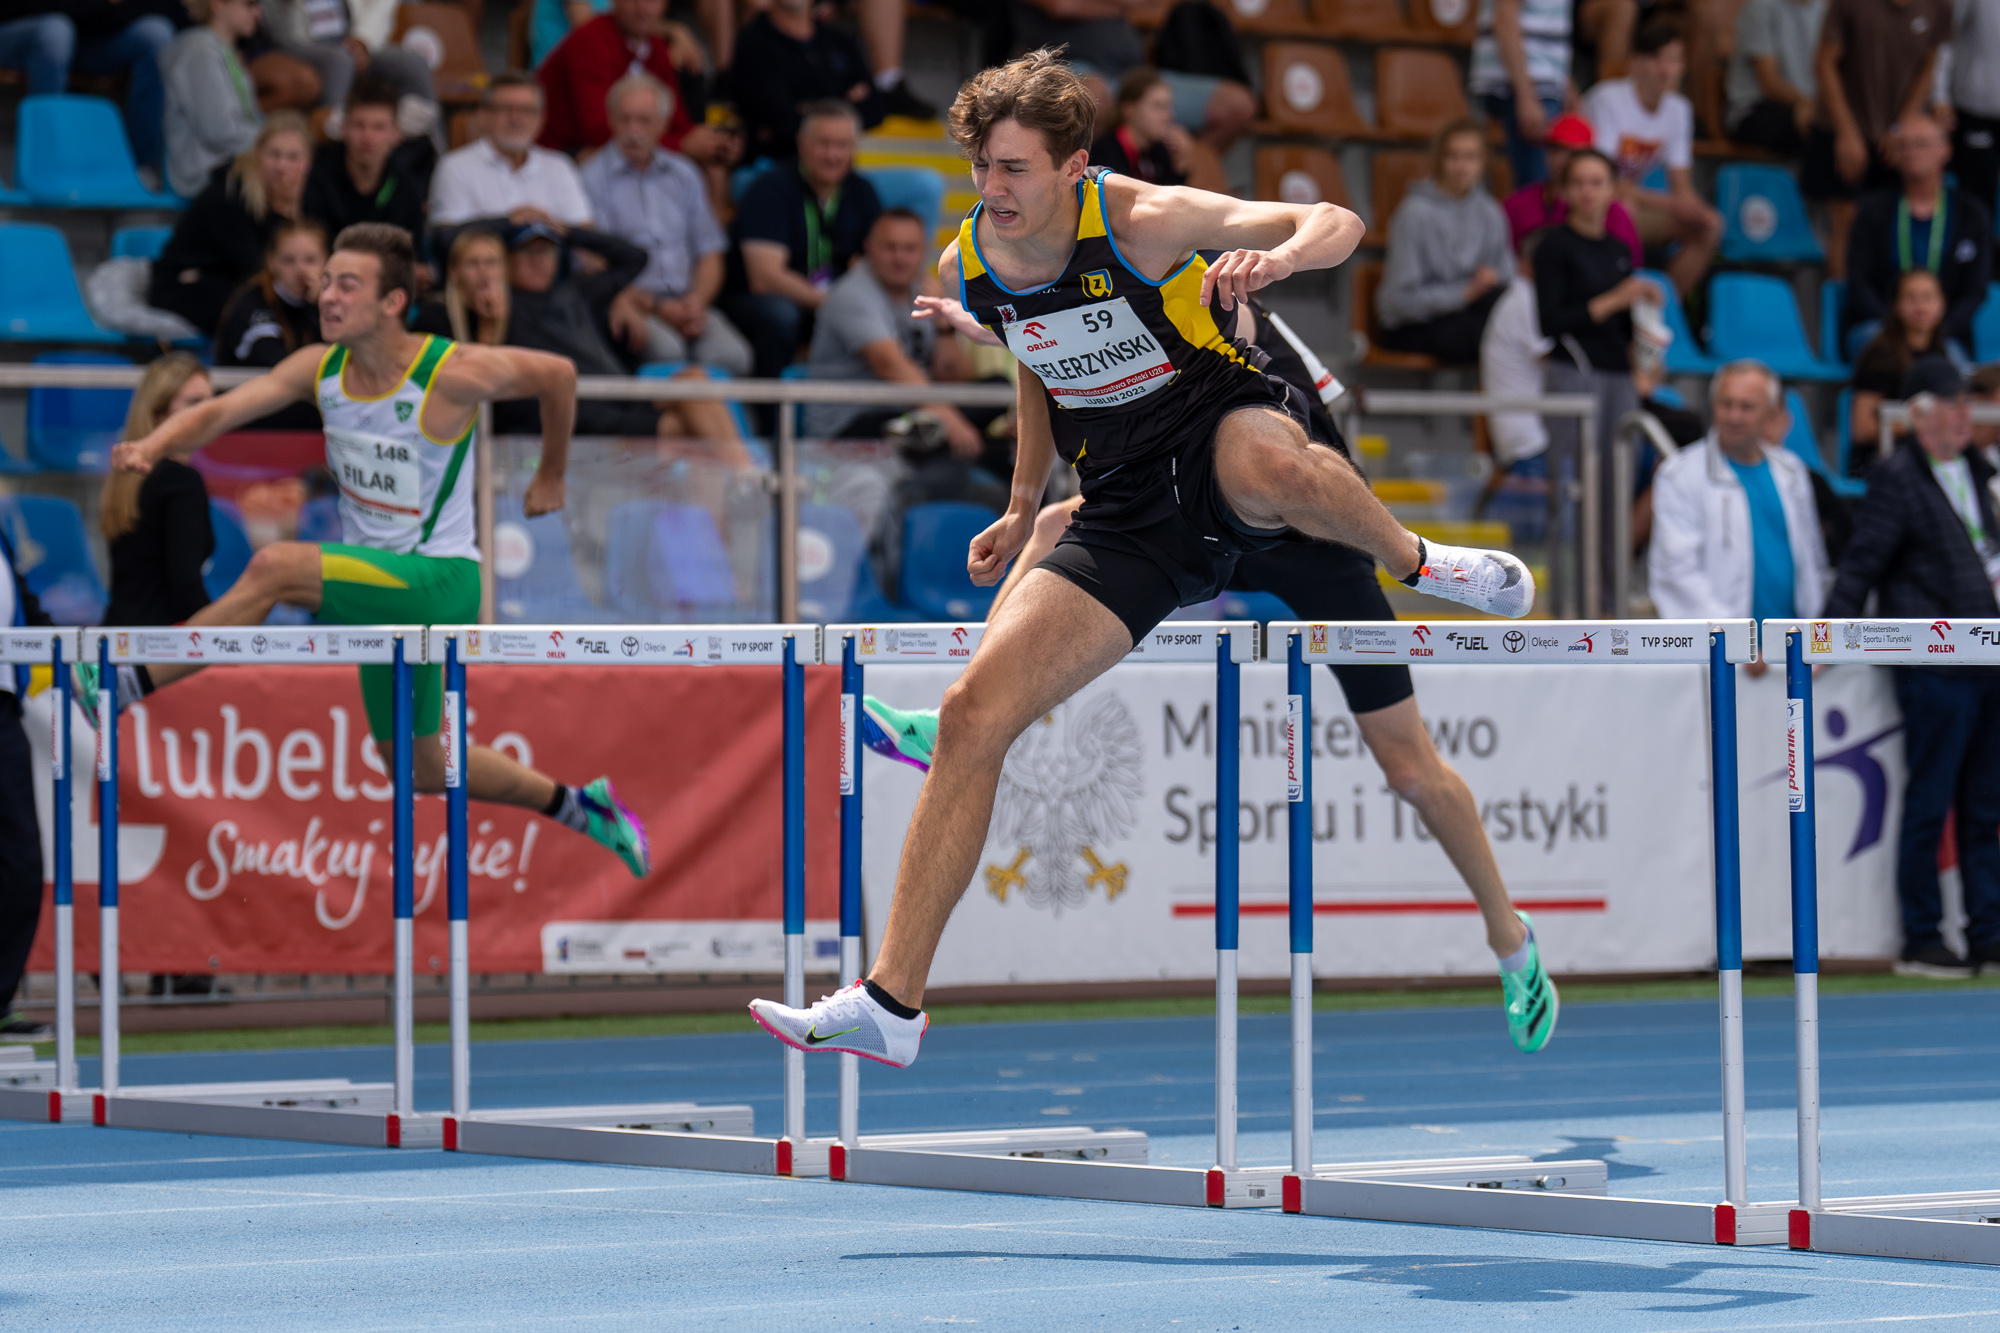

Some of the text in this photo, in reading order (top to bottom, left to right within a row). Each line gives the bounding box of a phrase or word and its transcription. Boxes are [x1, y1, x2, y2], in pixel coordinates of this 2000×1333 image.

[1081, 309, 1114, 334] 59
[1026, 339, 1059, 352] ORLEN
[1032, 333, 1157, 381] SELERZYŃSKI
[1126, 372, 1149, 388] Polski
[1148, 367, 1164, 378] U20
[1085, 385, 1146, 405] LUBLIN 2023
[374, 443, 409, 462] 148
[343, 464, 396, 494] FILAR
[1355, 629, 1386, 637] Ministerstwo
[1863, 625, 1899, 633] Ministerstwo
[348, 639, 384, 649] TVP SPORT
[900, 640, 914, 648] Sportu
[918, 640, 937, 648] Turystyki
[1156, 634, 1203, 645] TVP SPORT
[1355, 638, 1370, 647] Sportu
[1375, 638, 1396, 647] Turystyki
[1457, 636, 1489, 650] FUEL
[1531, 637, 1559, 649] Okęcie
[1641, 636, 1693, 647] TVP SPORT
[1863, 635, 1881, 644] Sportu
[1886, 635, 1912, 644] Turystyki
[219, 640, 242, 652] FUEL
[584, 641, 610, 653] FUEL
[731, 642, 773, 652] TVP SPORT
[949, 648, 970, 656] ORLEN
[1310, 643, 1327, 653] PZLA
[1410, 648, 1433, 656] ORLEN
[1567, 644, 1588, 653] polanik
[1811, 642, 1831, 652] PZLA
[1928, 644, 1955, 653] ORLEN
[1164, 701, 1498, 758] Mniewo
[130, 704, 533, 802] lubels
[840, 720, 848, 775] polanik
[1287, 723, 1297, 781] polanik
[1787, 727, 1799, 791] polanik
[1165, 782, 1608, 855] Sporu i Tustyki
[186, 815, 540, 929] Smakuj yie!
